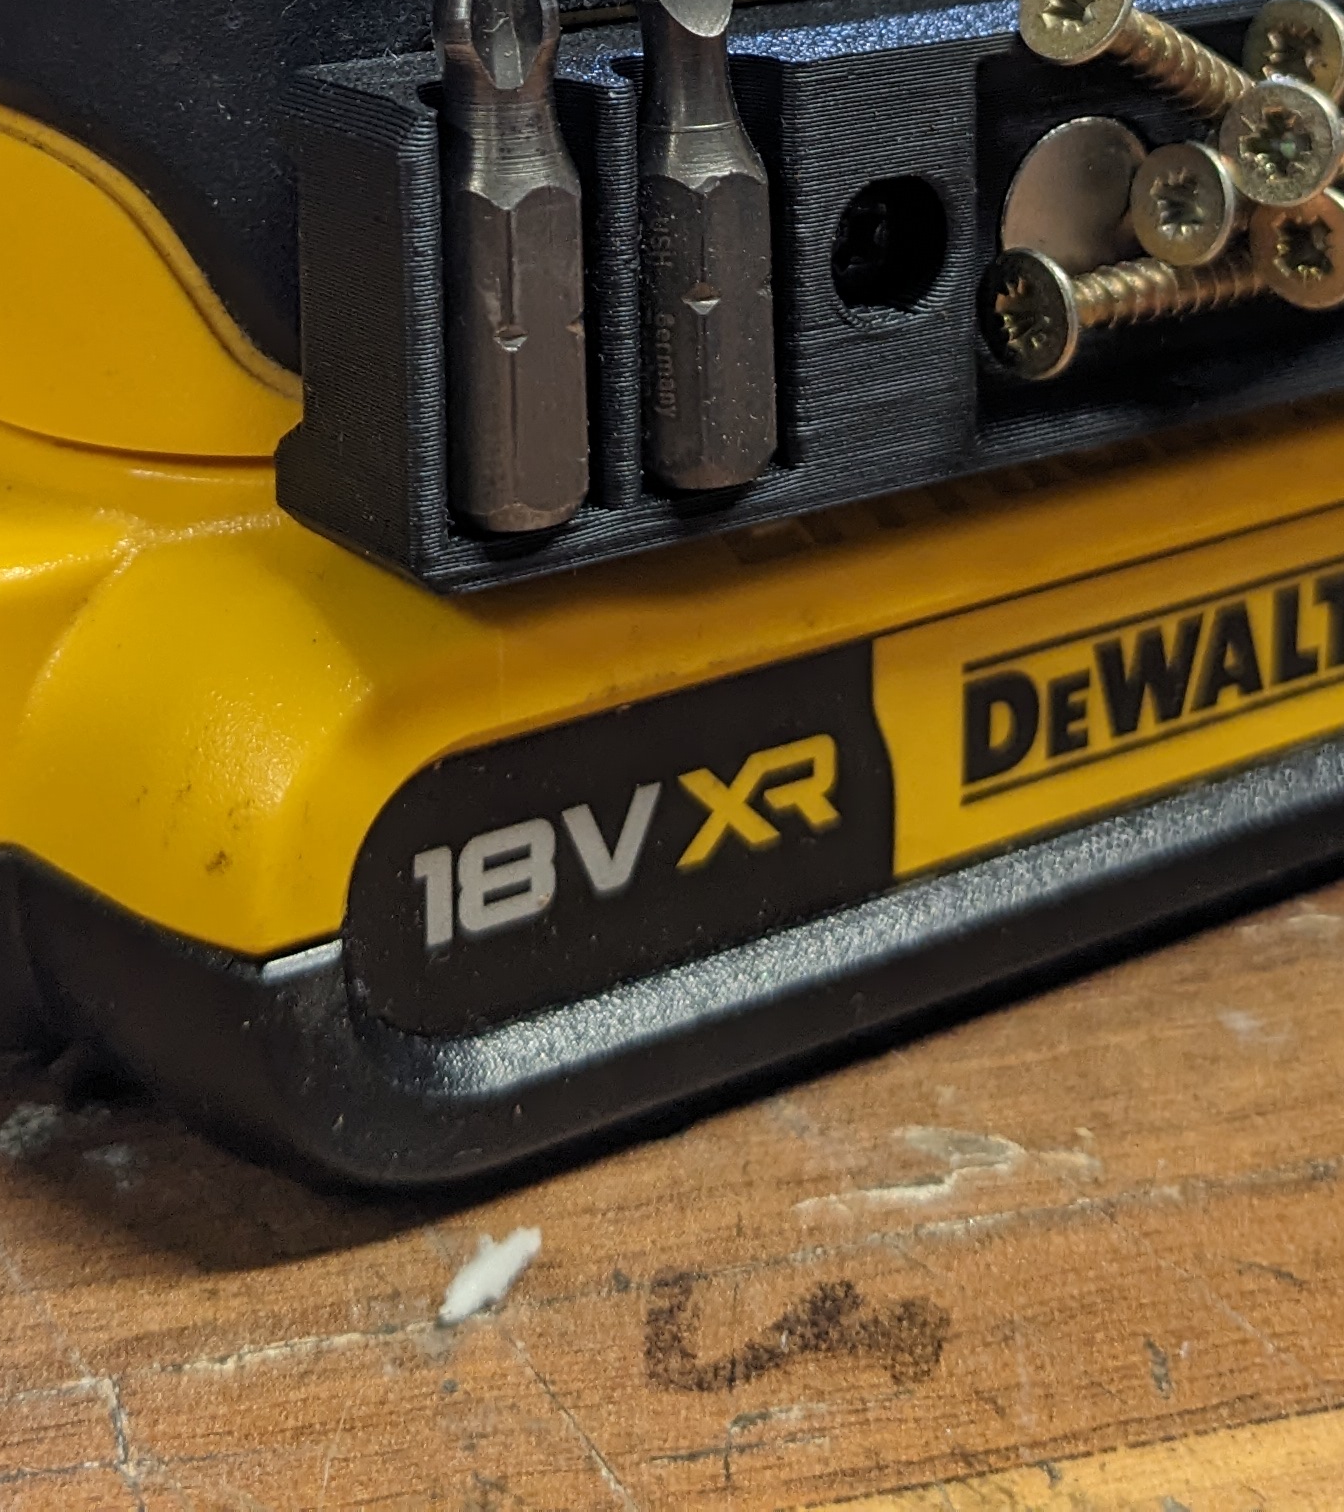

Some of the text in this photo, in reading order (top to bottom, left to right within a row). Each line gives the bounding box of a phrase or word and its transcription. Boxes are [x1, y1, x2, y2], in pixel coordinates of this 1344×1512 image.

[654, 313, 677, 418] Germany
[413, 733, 842, 950] 18V XR
